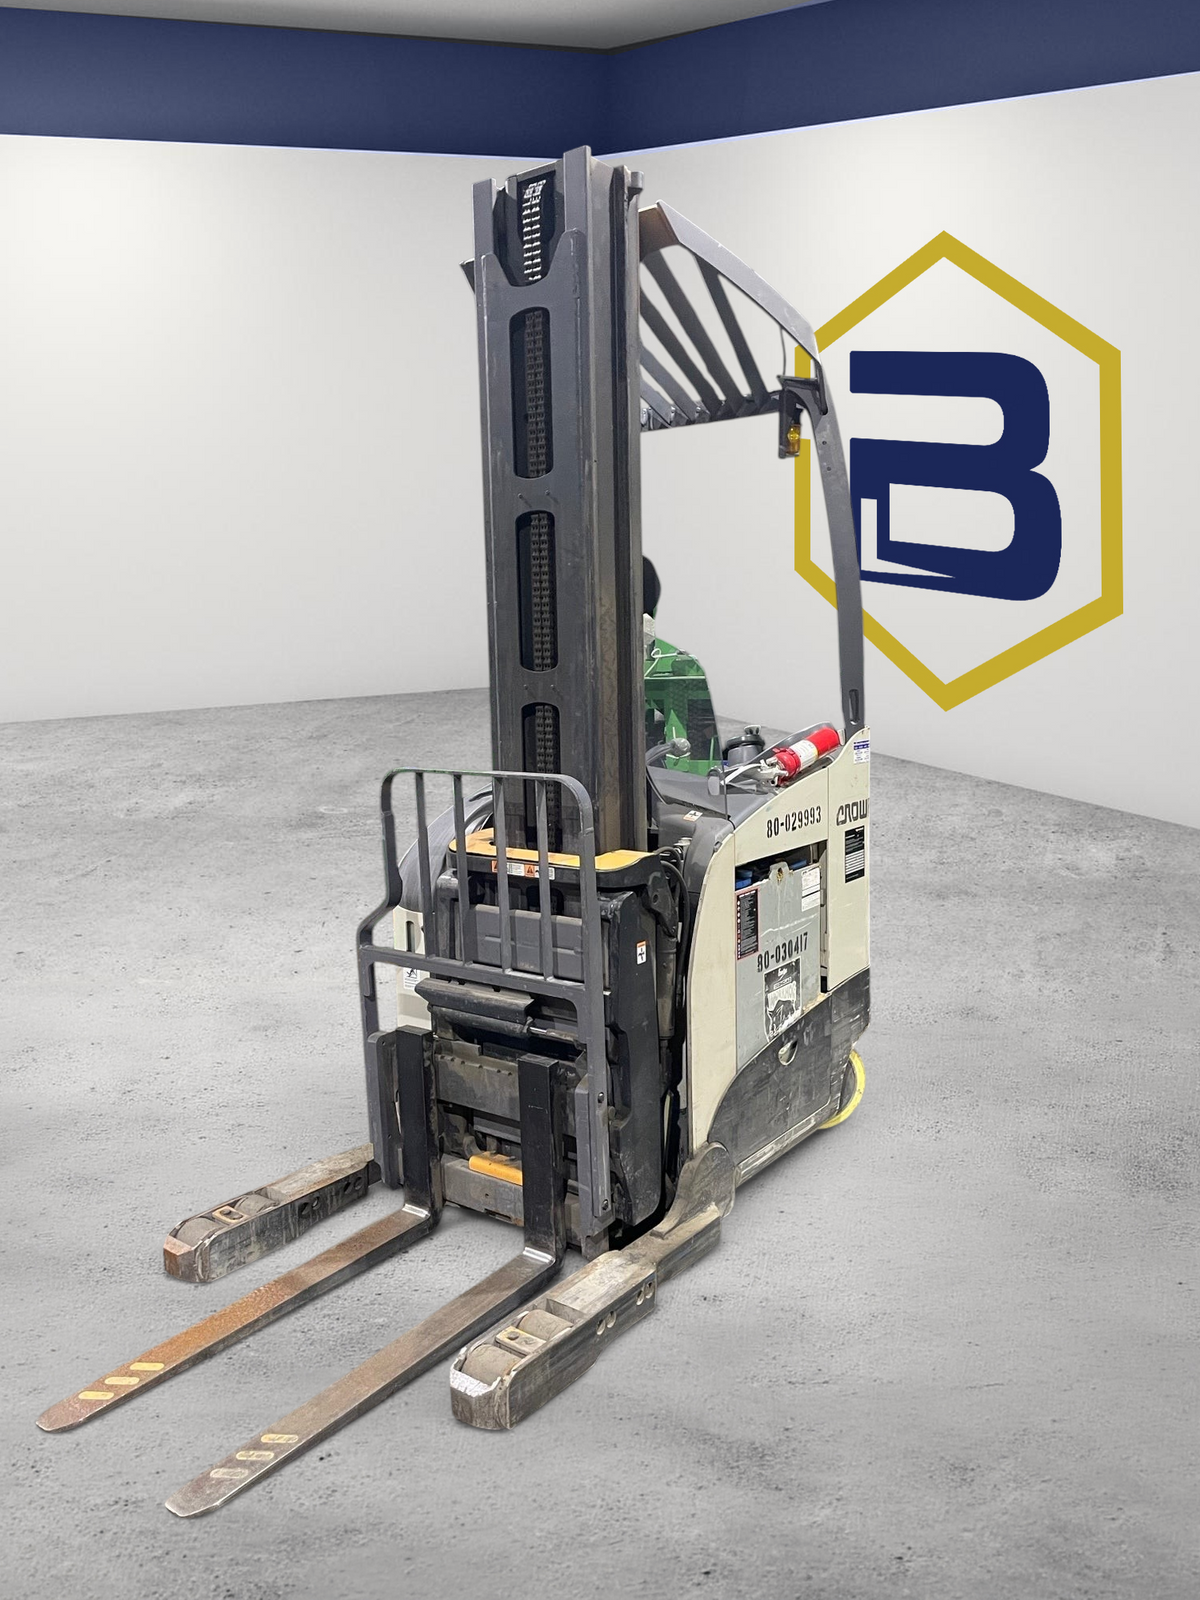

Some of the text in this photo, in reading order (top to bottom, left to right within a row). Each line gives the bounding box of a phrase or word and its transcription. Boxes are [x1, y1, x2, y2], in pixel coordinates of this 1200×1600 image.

[850, 351, 1062, 601] B
[767, 806, 821, 838] 80-029993
[836, 798, 869, 826] CROW
[757, 932, 808, 972] 80-030417
